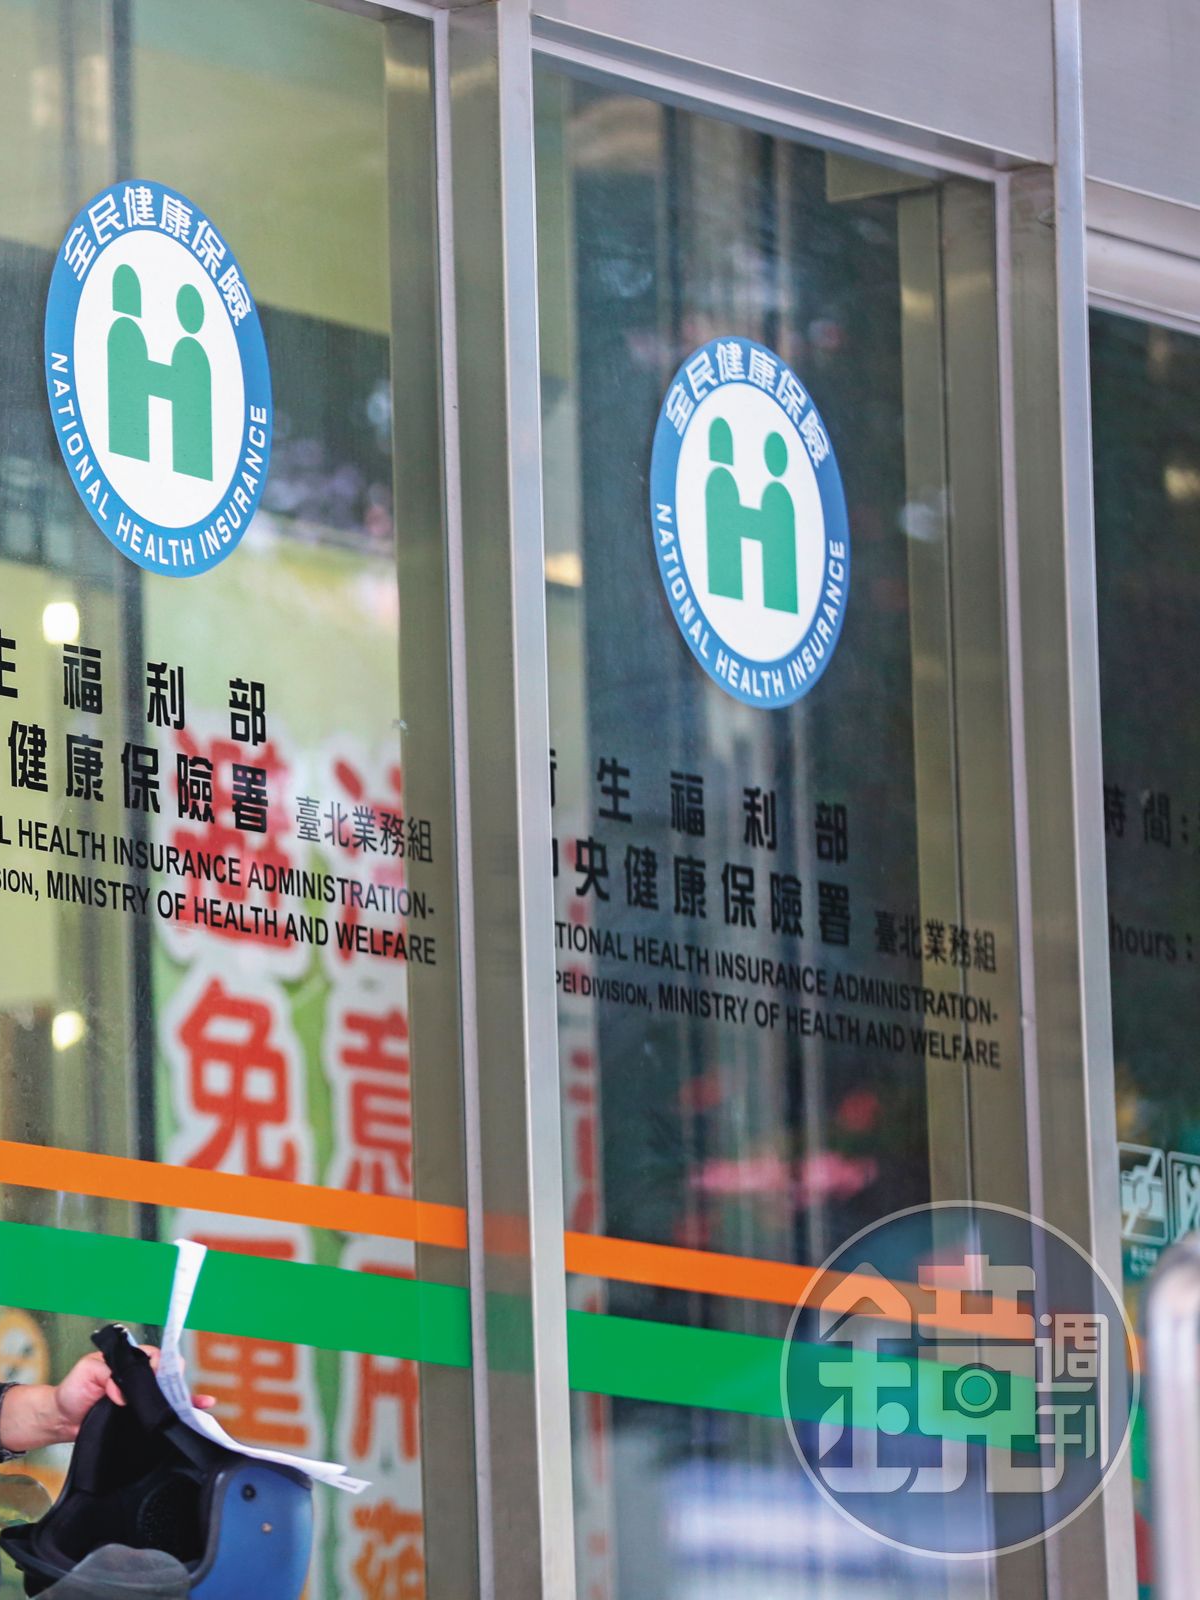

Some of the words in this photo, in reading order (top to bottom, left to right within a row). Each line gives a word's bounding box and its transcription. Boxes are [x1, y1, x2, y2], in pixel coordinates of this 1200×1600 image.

[64, 186, 253, 327] 全民健康保險
[50, 352, 109, 520] NATIONAL
[115, 512, 195, 567] HEALTH
[200, 405, 268, 561] INSURANCE
[665, 340, 831, 468] 全民健康保險
[656, 502, 710, 660] NATIONAL
[715, 648, 785, 700] HEALTH
[787, 539, 846, 687] INSURANCE
[18, 818, 106, 863] HEALTH
[113, 835, 242, 887] INSURANCE
[295, 795, 434, 864] 臺北業務組
[46, 869, 151, 915] MINISTRY
[157, 890, 186, 920] OF
[194, 898, 278, 939] HEALTH
[284, 913, 330, 946] AND
[335, 921, 437, 965] WELFARE
[552, 836, 852, 947] 央健康保險署
[874, 910, 998, 974] 臺北業務組
[555, 920, 629, 961] TIONAL
[633, 935, 709, 976] HEALTH
[715, 956, 828, 997] INSURANCE
[556, 970, 578, 994] PEI
[580, 975, 653, 1012] DIVISION,
[657, 983, 749, 1025] MINISTRY
[754, 1000, 781, 1031] OF
[785, 1008, 863, 1046] HEALTH
[865, 1021, 906, 1054] AND
[911, 1030, 1001, 1068] WELFARE
